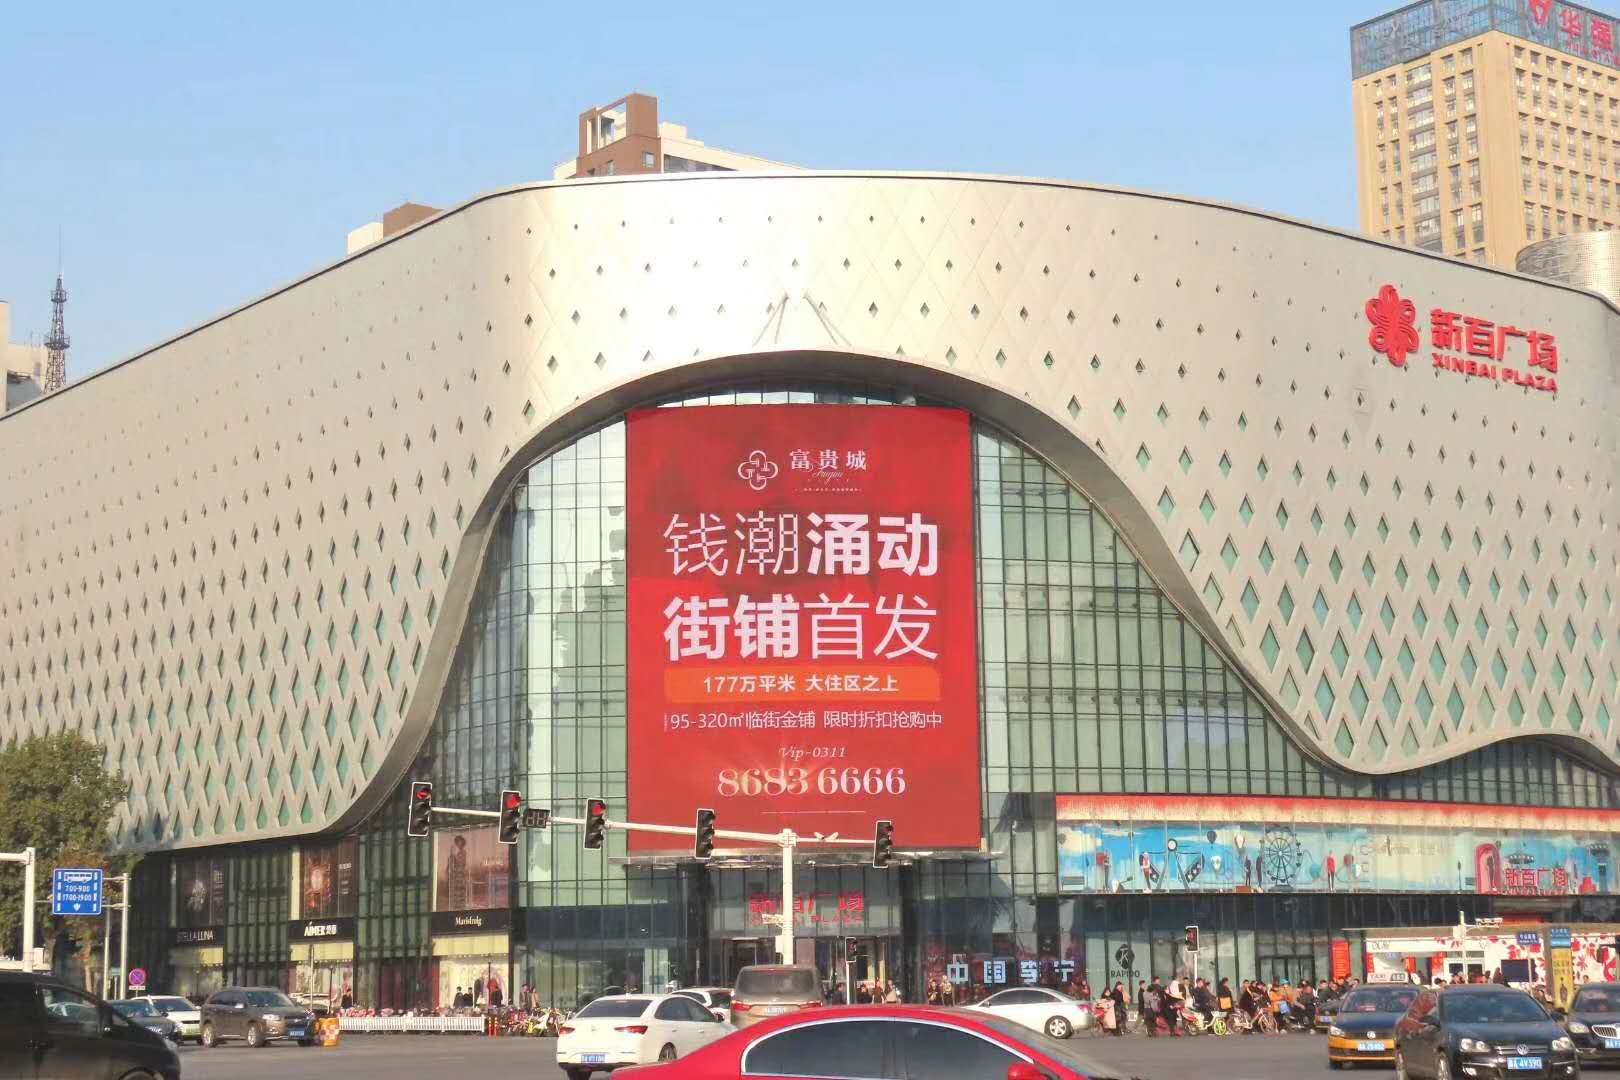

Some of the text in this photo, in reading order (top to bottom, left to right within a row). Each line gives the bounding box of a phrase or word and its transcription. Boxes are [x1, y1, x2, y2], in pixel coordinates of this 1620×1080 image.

[1430, 308, 1558, 374] 新百广场
[1432, 352, 1558, 394] XINBAI PLAZA
[789, 448, 867, 471] 富贵城
[663, 510, 938, 577] 钱潮涌动
[663, 593, 939, 662] 街铺首发
[703, 674, 899, 693] 177万平米 大住区之上
[823, 710, 942, 729] 限时折扣抢购中
[717, 767, 907, 797] 8683 6666
[947, 958, 1075, 985] 中国李宁
